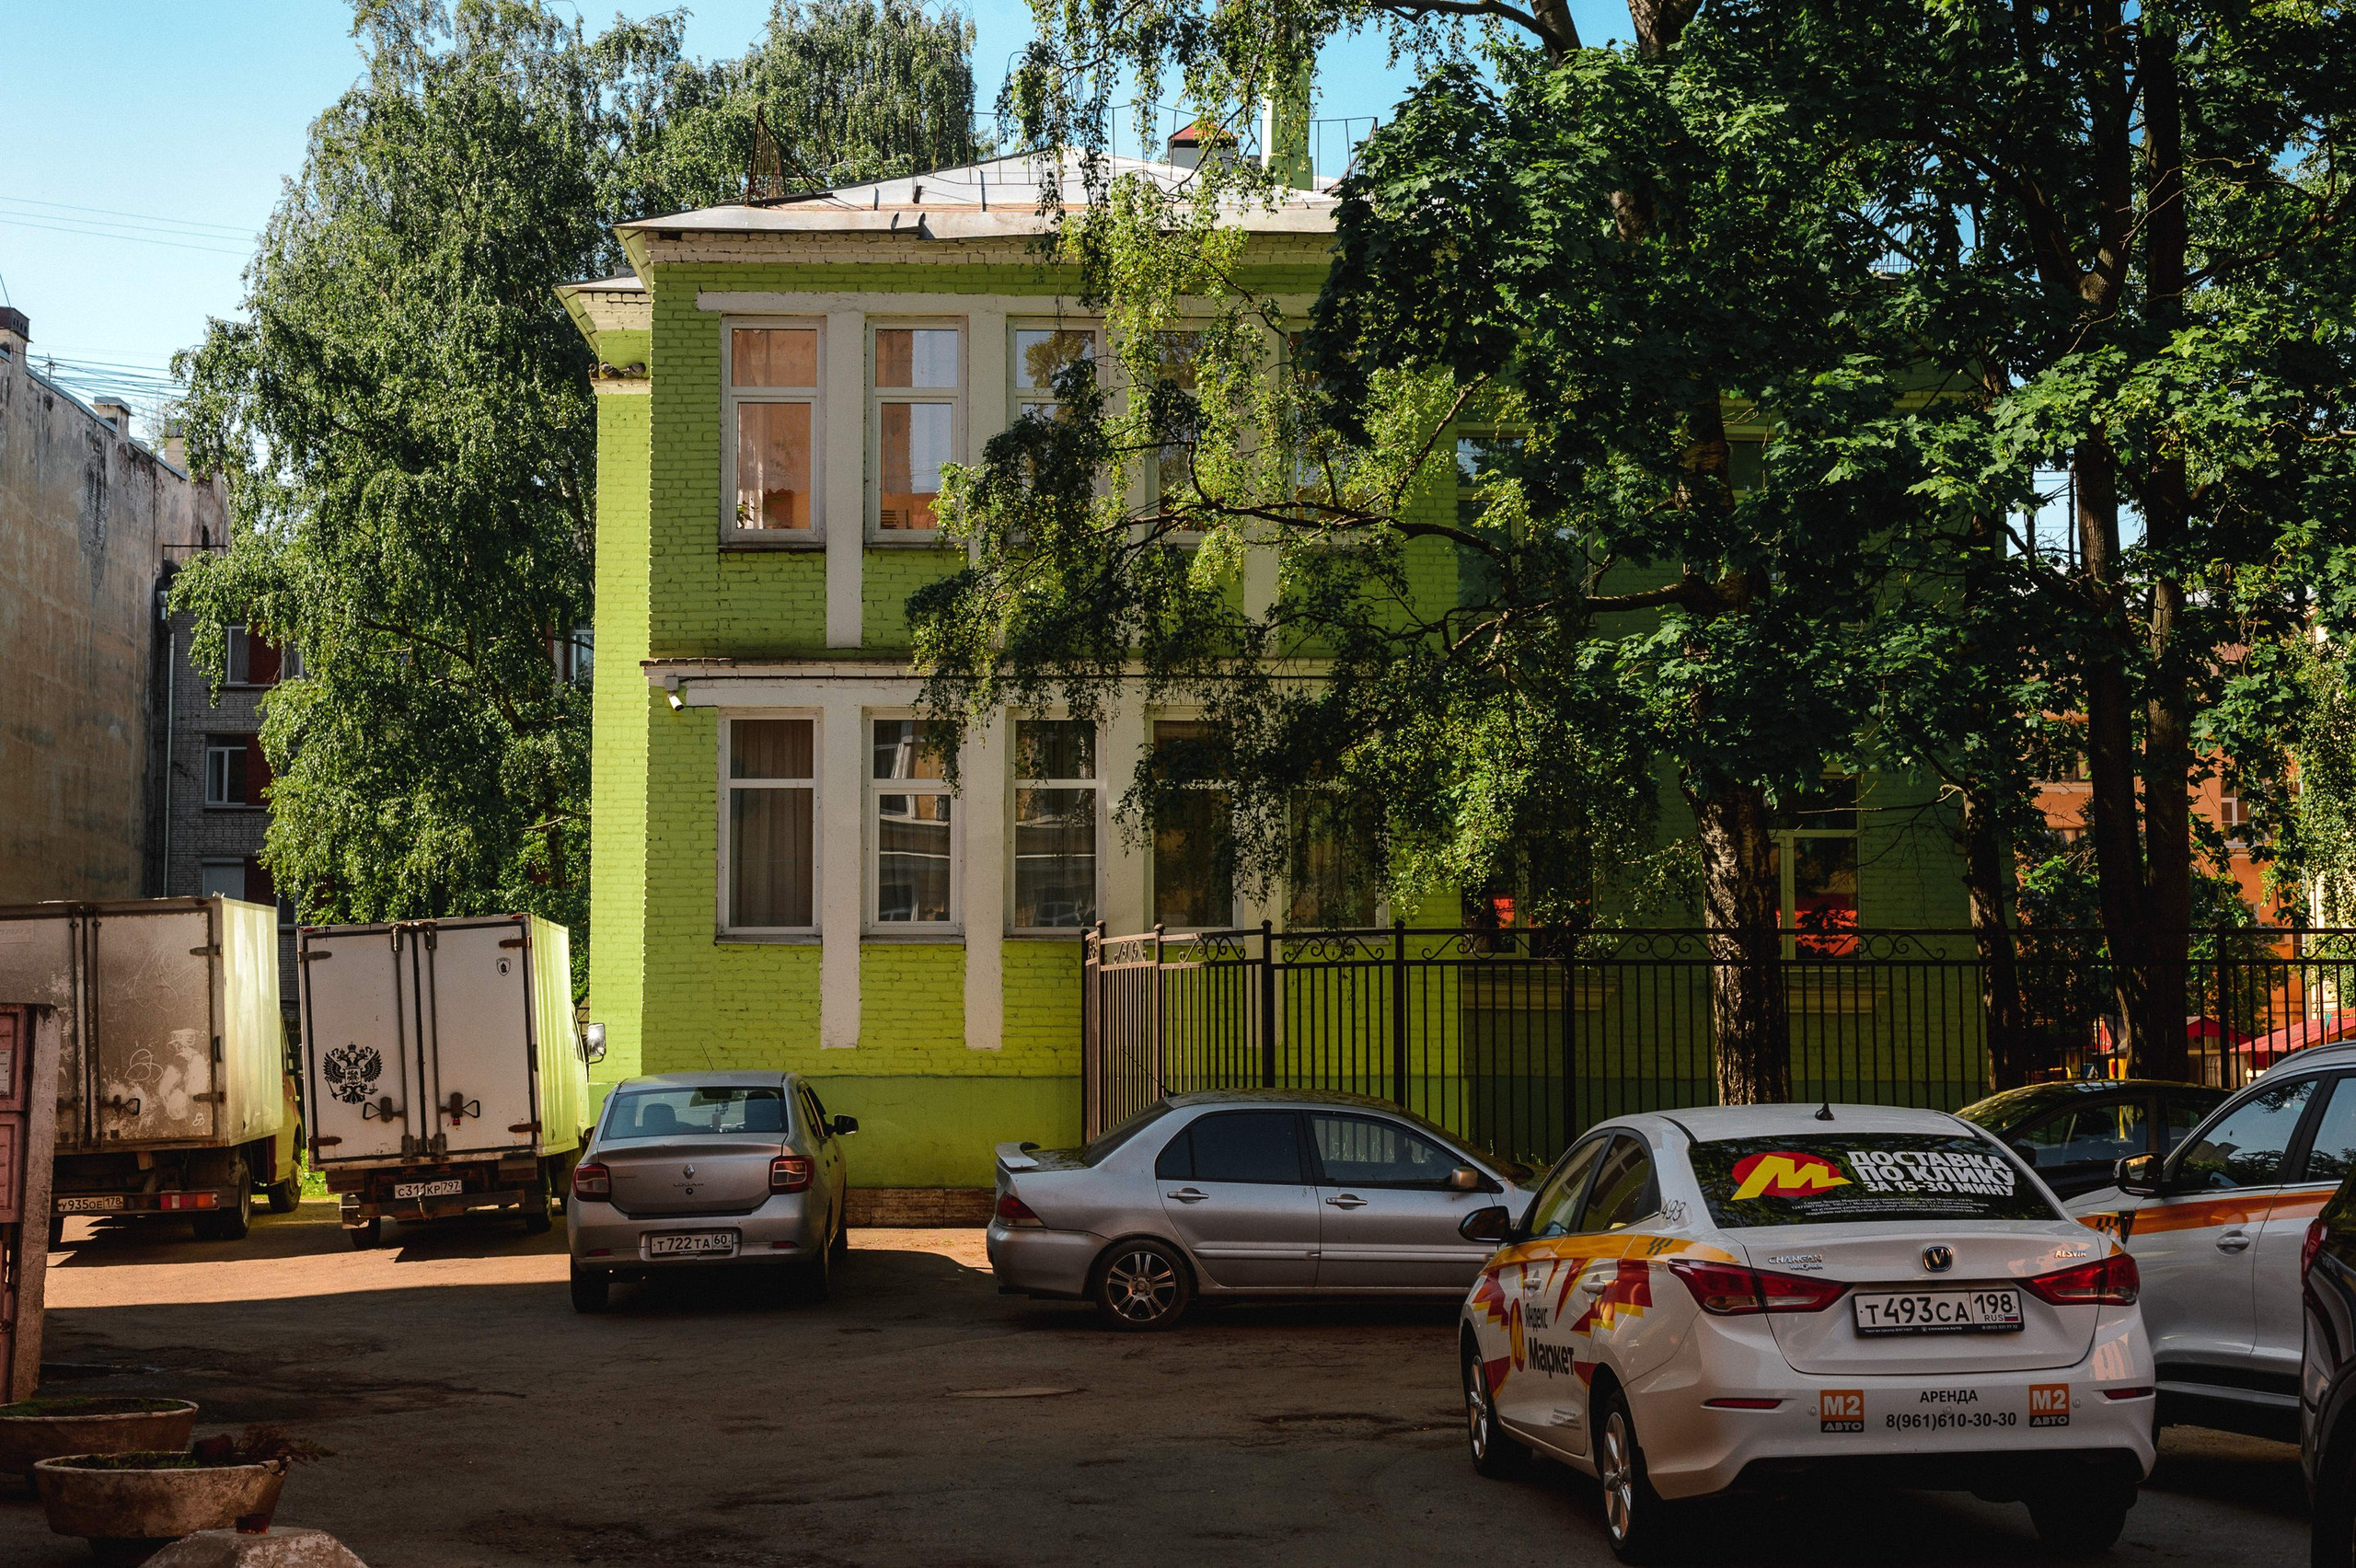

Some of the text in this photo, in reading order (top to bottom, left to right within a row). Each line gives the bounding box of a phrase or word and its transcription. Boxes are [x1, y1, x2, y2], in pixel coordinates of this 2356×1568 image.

[1846, 1151, 2012, 1171] ДОСТАВКА
[442, 1181, 459, 1191] 797
[1854, 1166, 2015, 1186] ПО КЛИКУ
[1863, 1181, 1894, 1193] ЗА
[1894, 1181, 1953, 1193] 15-30
[61, 1197, 121, 1211] У935ОЕ 178
[1660, 1199, 1686, 1222] 493
[657, 1234, 727, 1251] Т722ТА 60
[1768, 1254, 1823, 1264] CHANGAN
[1525, 1302, 1548, 1332] Яндекс
[1865, 1293, 2014, 1325] Т493СА 198
[1983, 1313, 2004, 1322] RUS
[1529, 1337, 1574, 1378] Маркет
[1823, 1395, 1861, 1416] М2
[1920, 1389, 1978, 1404] АРЕНДА
[2032, 1389, 2066, 1410] М2
[1886, 1412, 2017, 1432] 8(961)610-30-30
